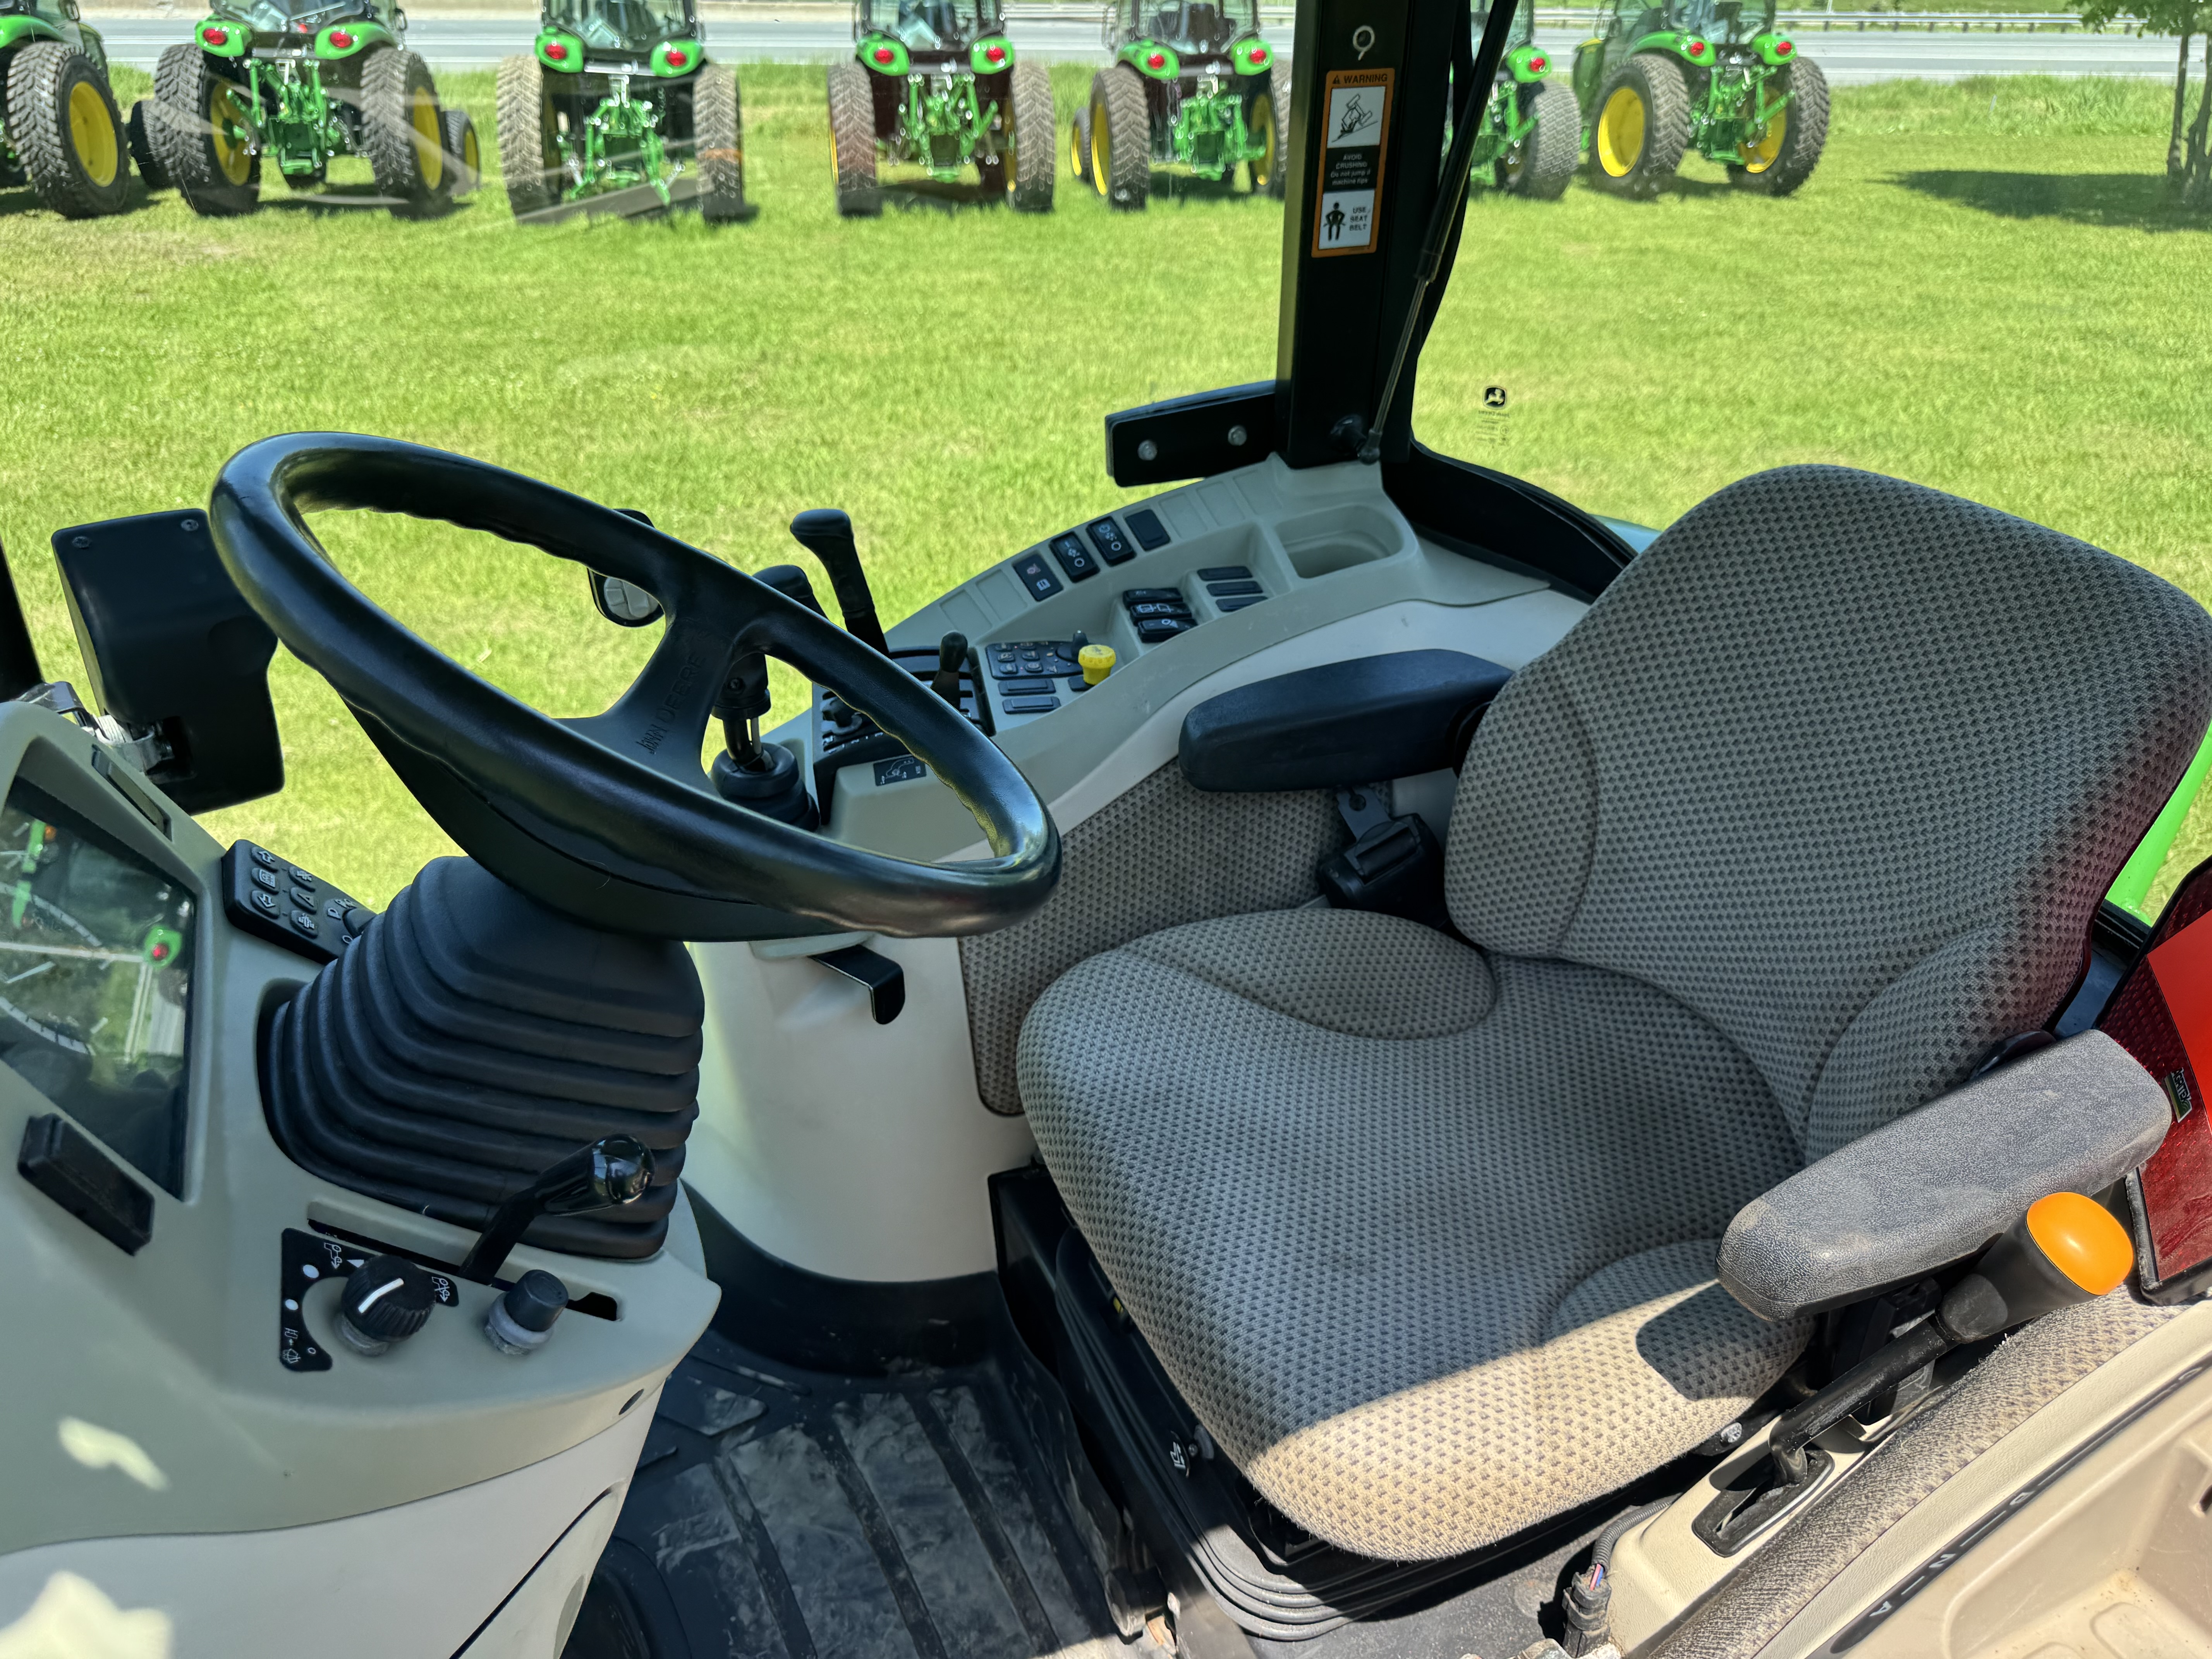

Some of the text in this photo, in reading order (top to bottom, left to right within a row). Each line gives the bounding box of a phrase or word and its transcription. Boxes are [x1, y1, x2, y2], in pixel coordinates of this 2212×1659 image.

[1344, 74, 1388, 84] WARNING
[635, 653, 706, 755] JOHN DEERE
[2171, 1067, 2191, 1104] AGRITEX
[1929, 1553, 1956, 1568] N
[1869, 1601, 1892, 1617] A
